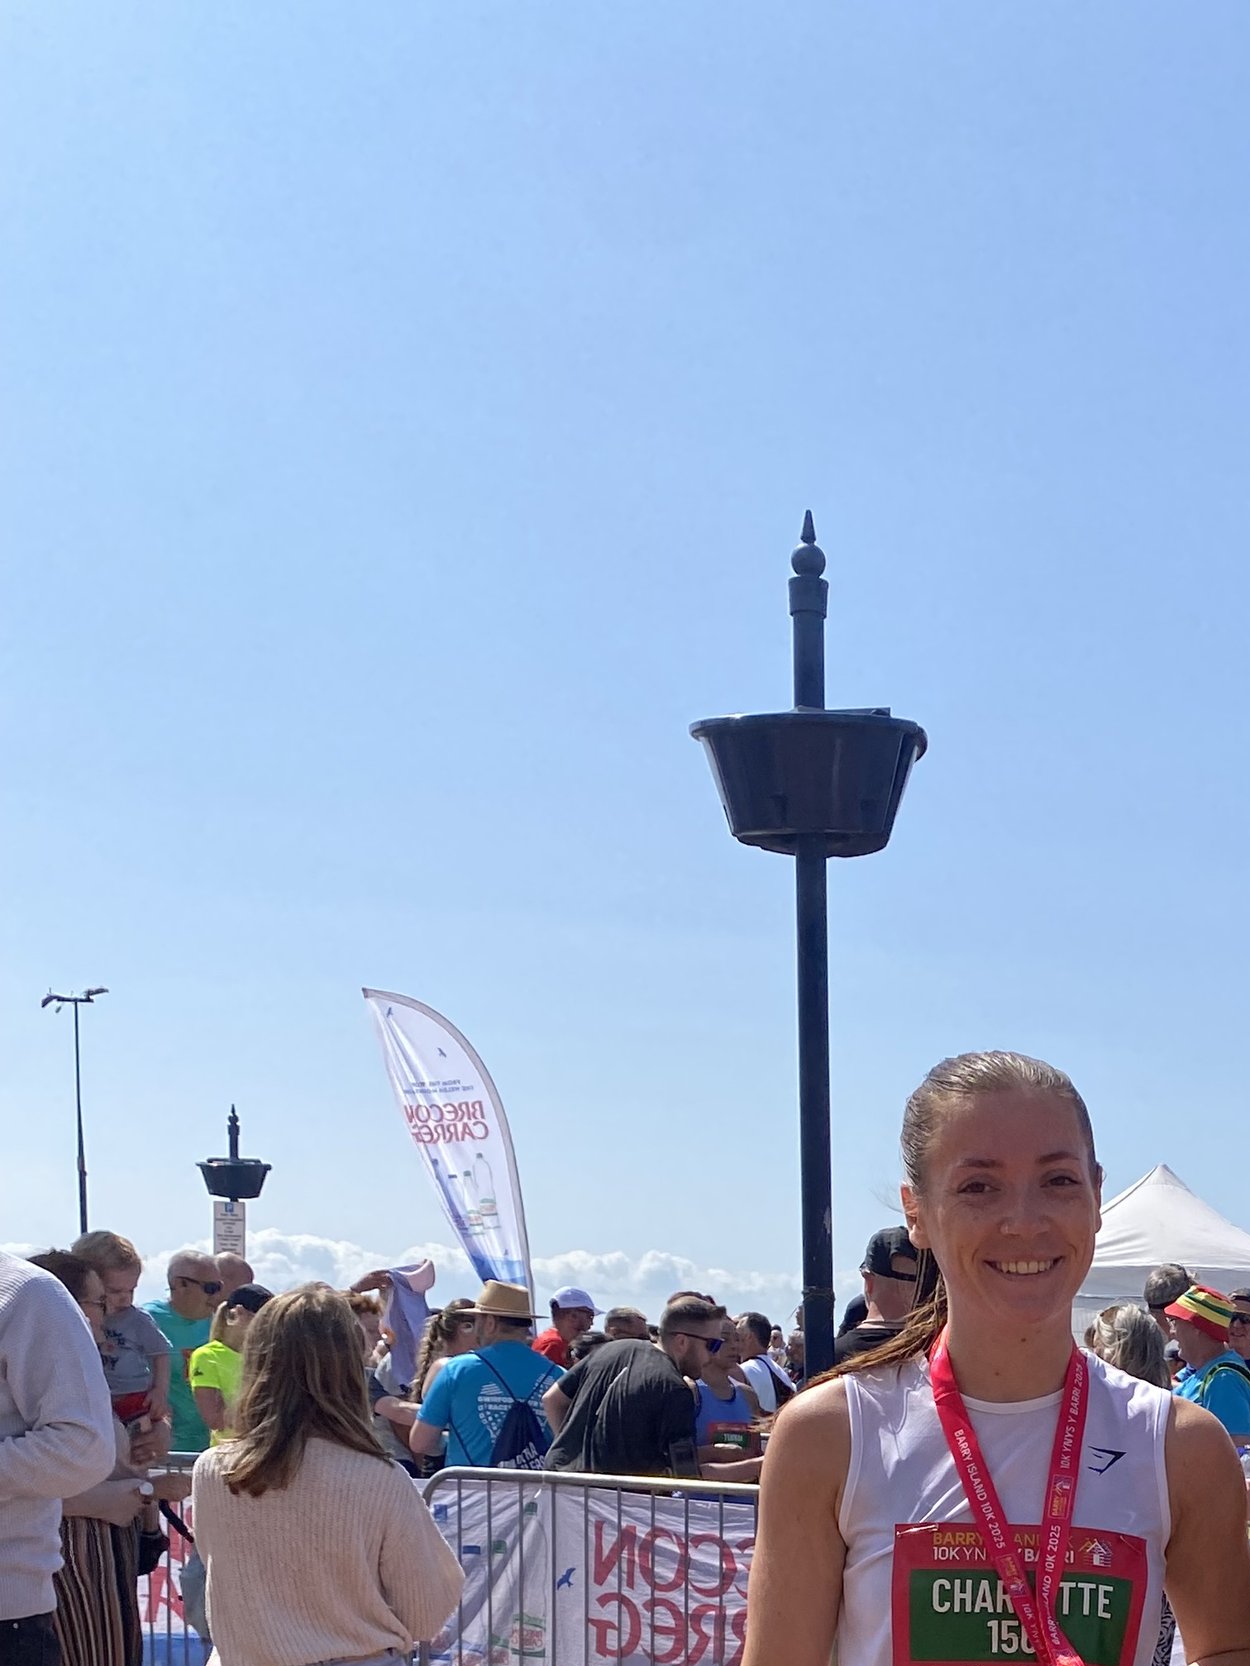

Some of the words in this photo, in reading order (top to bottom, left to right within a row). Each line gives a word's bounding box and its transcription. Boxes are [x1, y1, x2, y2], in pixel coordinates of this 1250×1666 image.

[1069, 1387, 1082, 1417] BARRI
[1062, 1425, 1075, 1453] YNYS
[1060, 1454, 1070, 1469] 10K
[954, 1429, 973, 1461] BARRY
[966, 1462, 987, 1501] ISLAND
[980, 1502, 996, 1525] 10K
[988, 1522, 1006, 1549] 2025
[933, 1547, 960, 1560] 10K
[1044, 1552, 1057, 1574] 10K
[1051, 1525, 1061, 1552] 2025
